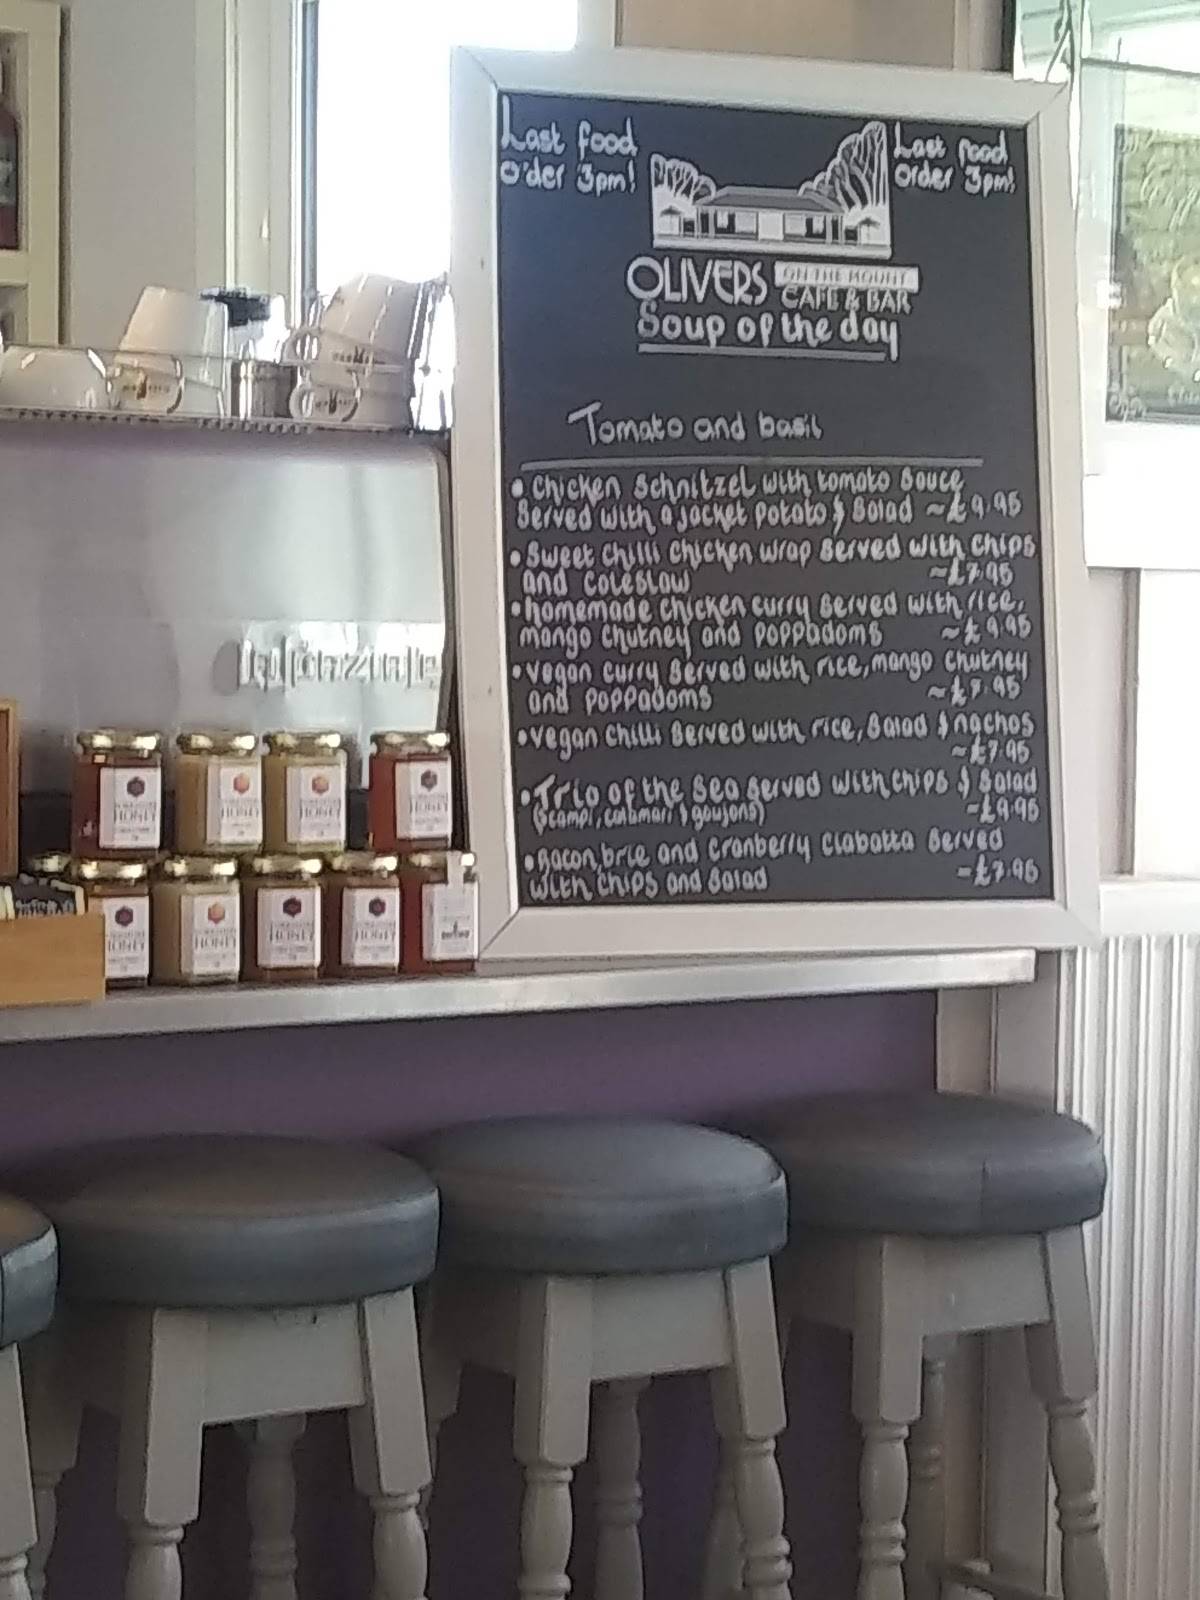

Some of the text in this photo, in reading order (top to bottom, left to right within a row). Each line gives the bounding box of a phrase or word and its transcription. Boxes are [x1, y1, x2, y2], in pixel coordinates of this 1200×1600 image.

[501, 94, 638, 161] Last food
[894, 121, 1009, 169] Last food
[576, 158, 636, 197] 3pm!
[964, 164, 1016, 197] 3pm!
[626, 255, 768, 306] OLIVERS
[865, 288, 913, 316] BAR
[636, 299, 899, 363] Soup of the day
[566, 401, 823, 446] Tomato and basil
[762, 468, 813, 499] with
[817, 466, 891, 495] tomato
[600, 503, 657, 536] with
[660, 504, 673, 527] a
[754, 499, 828, 531] potato
[759, 539, 812, 568] wrap
[908, 533, 966, 561] with
[524, 594, 653, 629] homemade
[907, 590, 964, 620] with
[519, 624, 592, 660] mango
[701, 619, 742, 648] and
[754, 654, 811, 685] with
[527, 686, 570, 715] and
[751, 716, 807, 745] with
[532, 773, 600, 811] Trio
[607, 777, 637, 809] of
[641, 775, 685, 809] the
[832, 768, 891, 800] with
[656, 836, 700, 866] and
[529, 872, 594, 901] with
[665, 867, 703, 896] and
